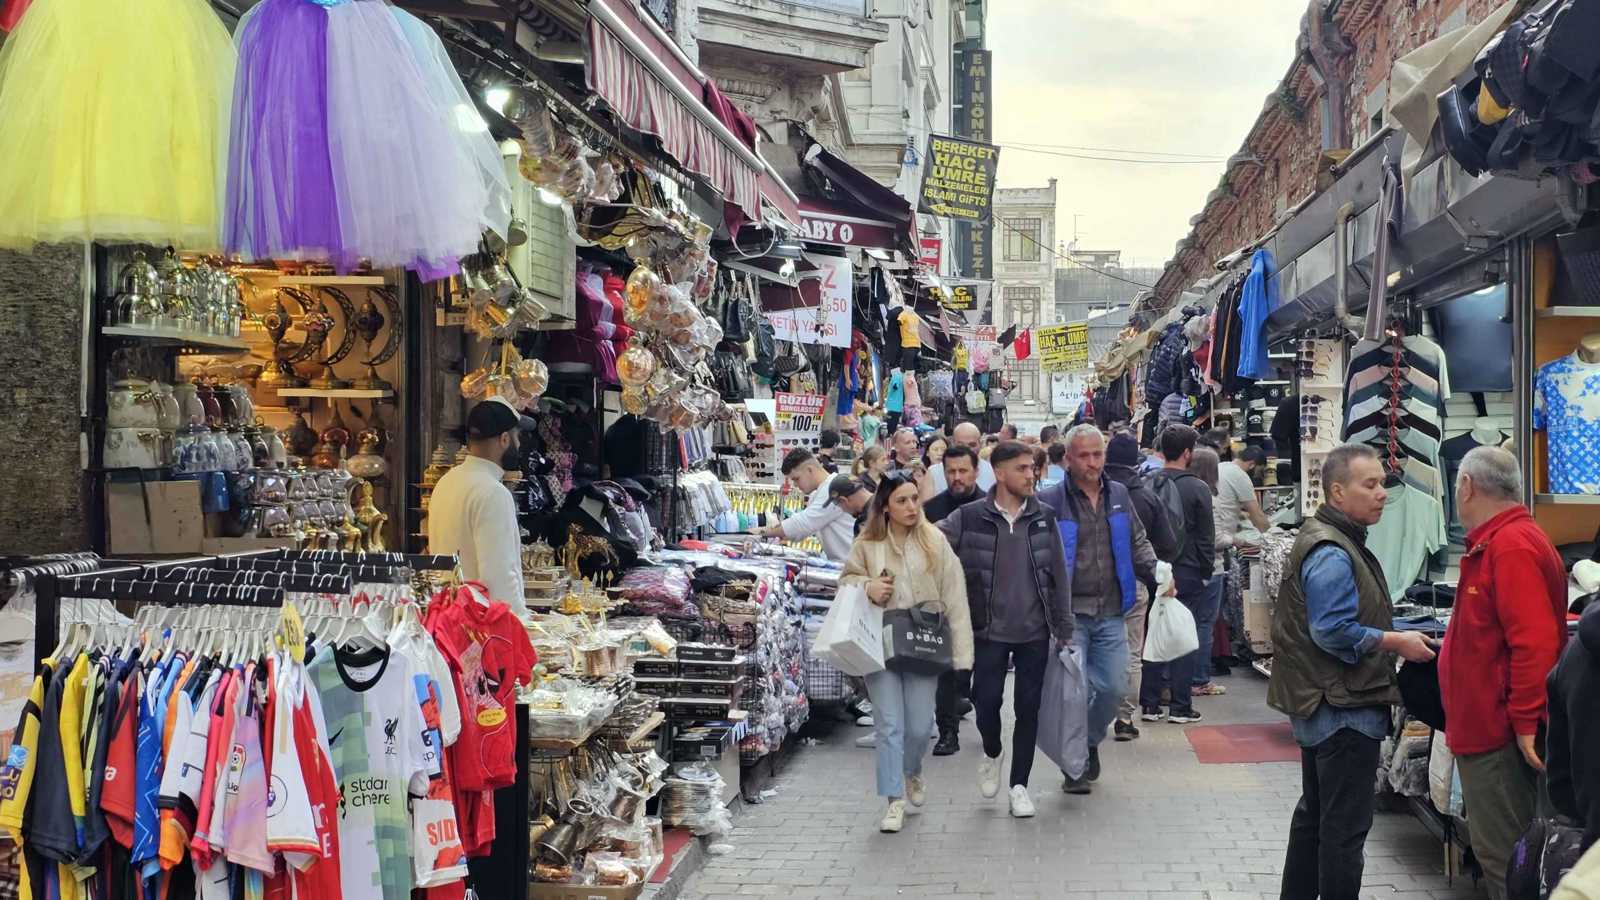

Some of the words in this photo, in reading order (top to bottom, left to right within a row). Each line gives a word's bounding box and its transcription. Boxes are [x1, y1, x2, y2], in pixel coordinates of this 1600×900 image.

[933, 139, 994, 159] BEREKET
[935, 153, 976, 170] HAC
[932, 166, 987, 185] UMRE
[800, 218, 836, 241] ABY
[792, 414, 812, 431] 100
